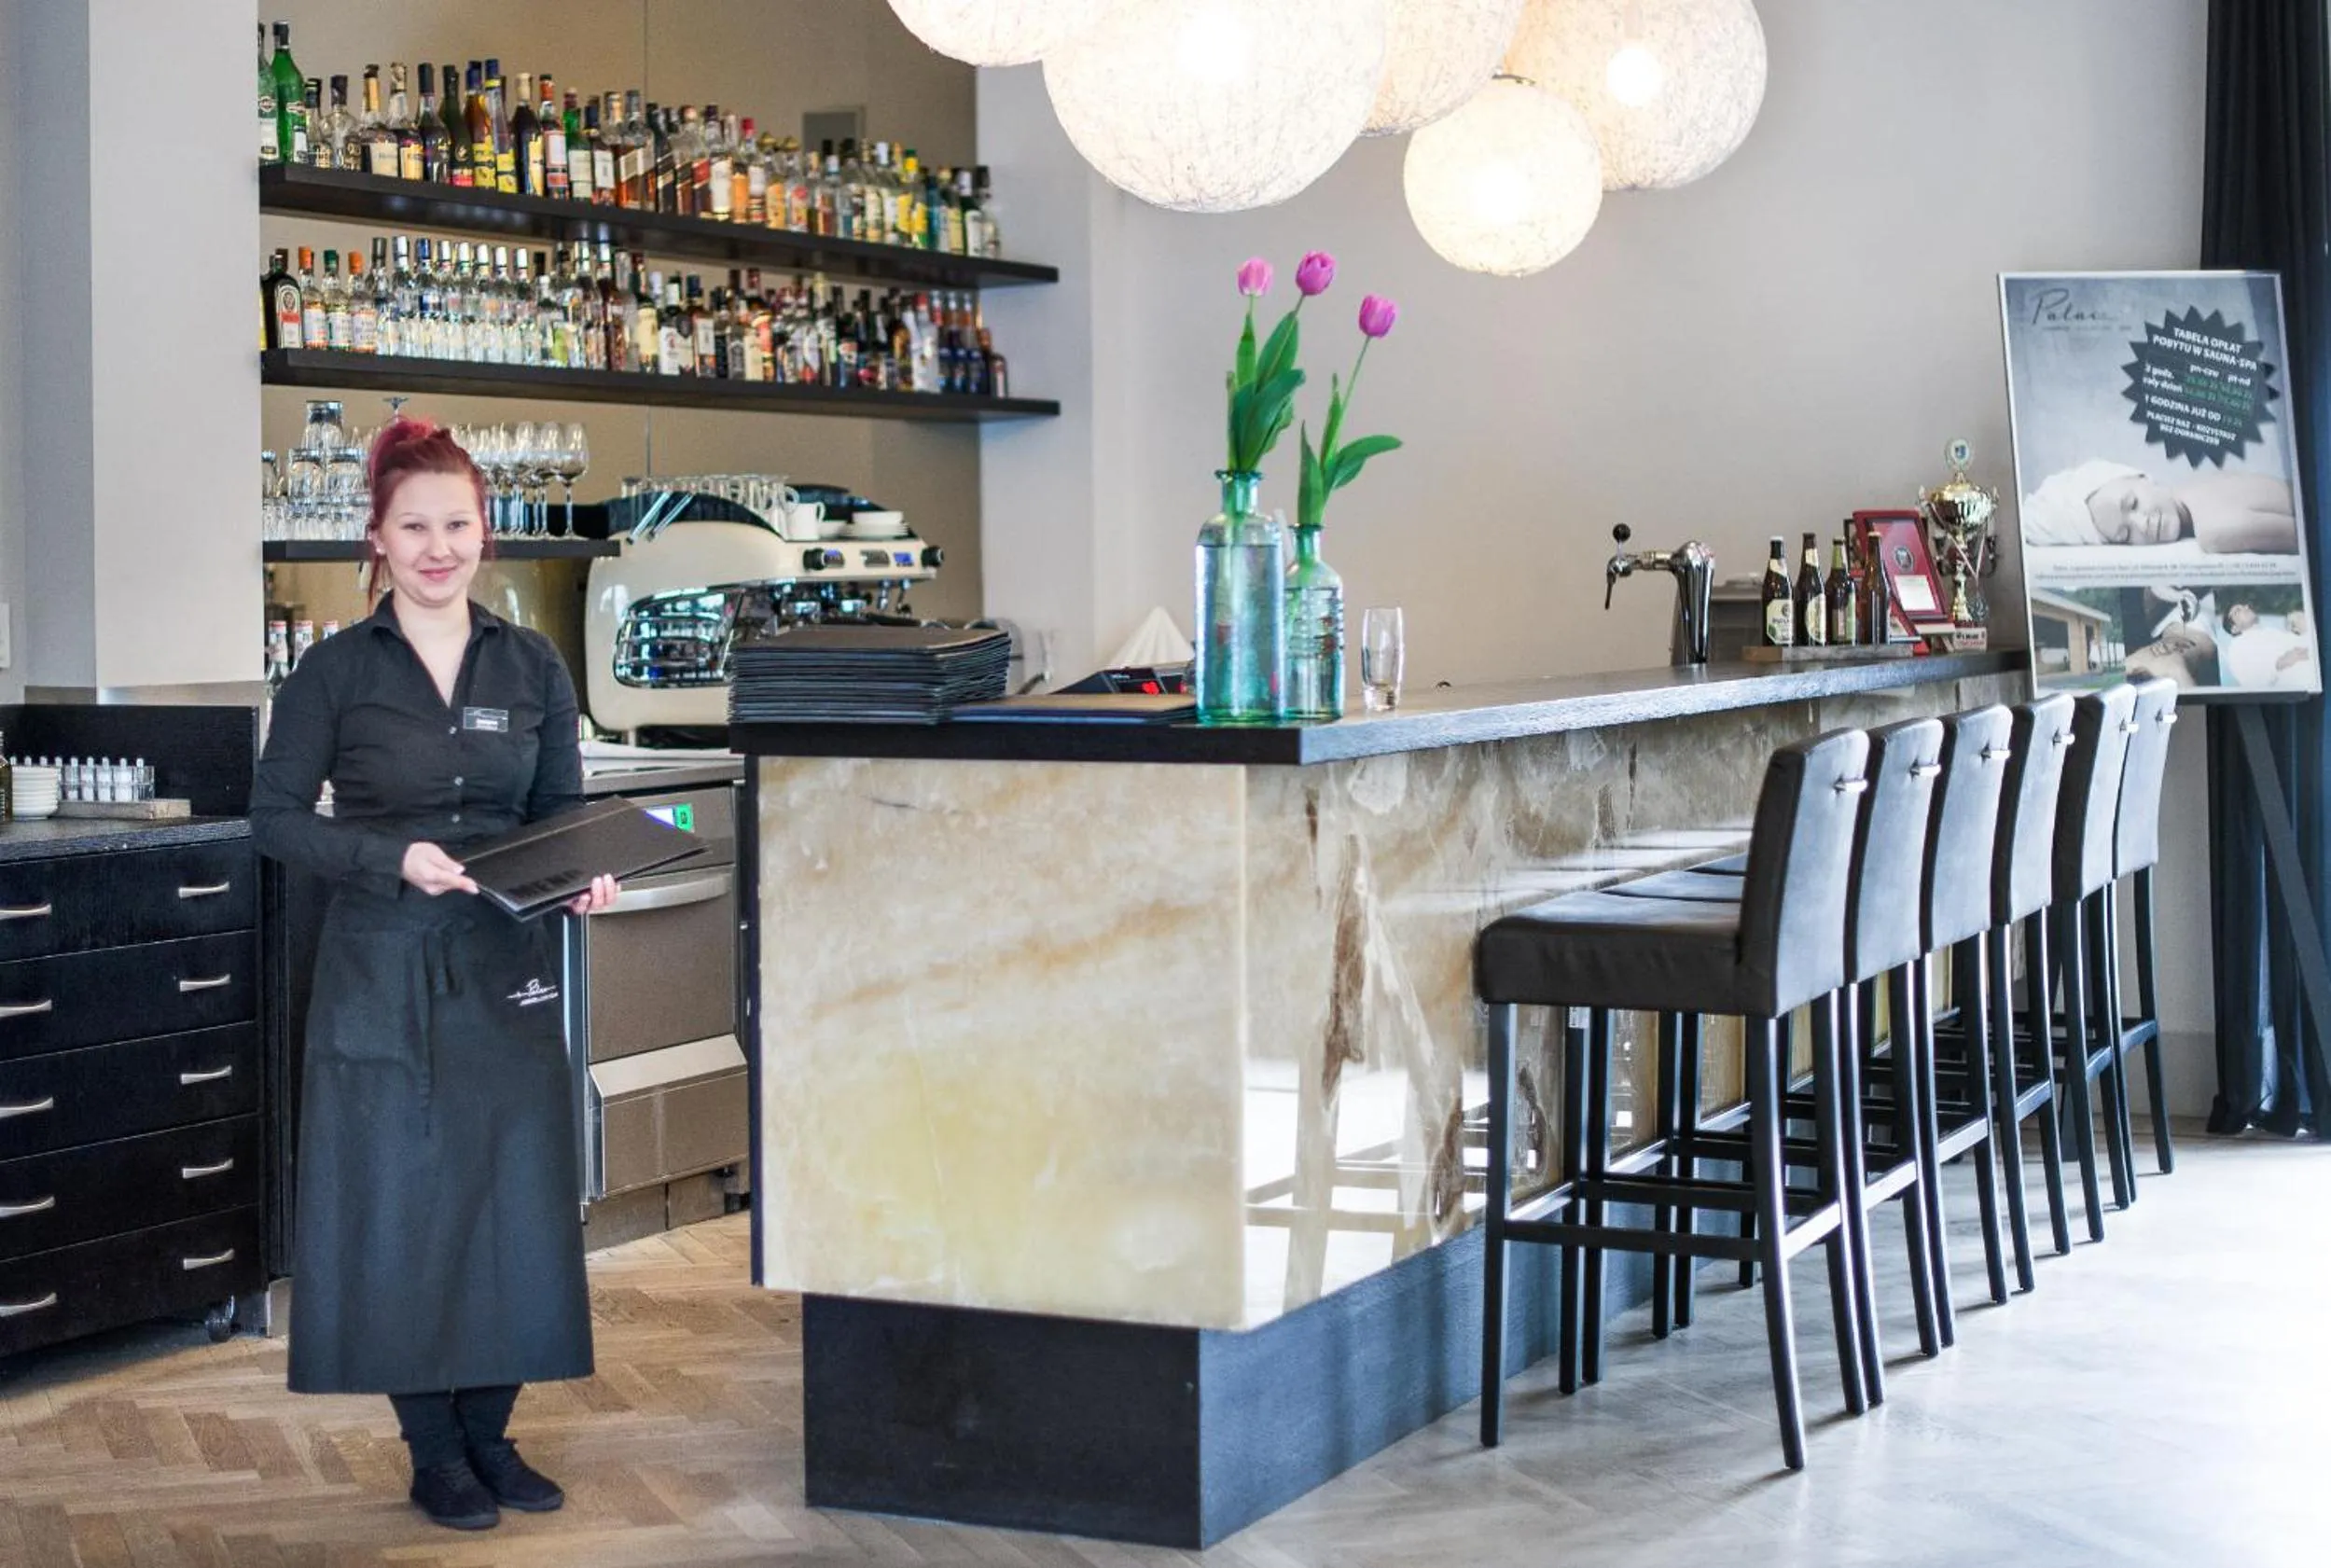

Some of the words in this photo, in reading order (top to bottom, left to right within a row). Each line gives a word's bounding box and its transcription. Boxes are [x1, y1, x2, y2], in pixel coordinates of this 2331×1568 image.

[2153, 335, 2191, 353] POBYTU
[2192, 345, 2202, 356] W
[2173, 327, 2209, 346] TABELA
[2150, 395, 2190, 415] GODZINA
